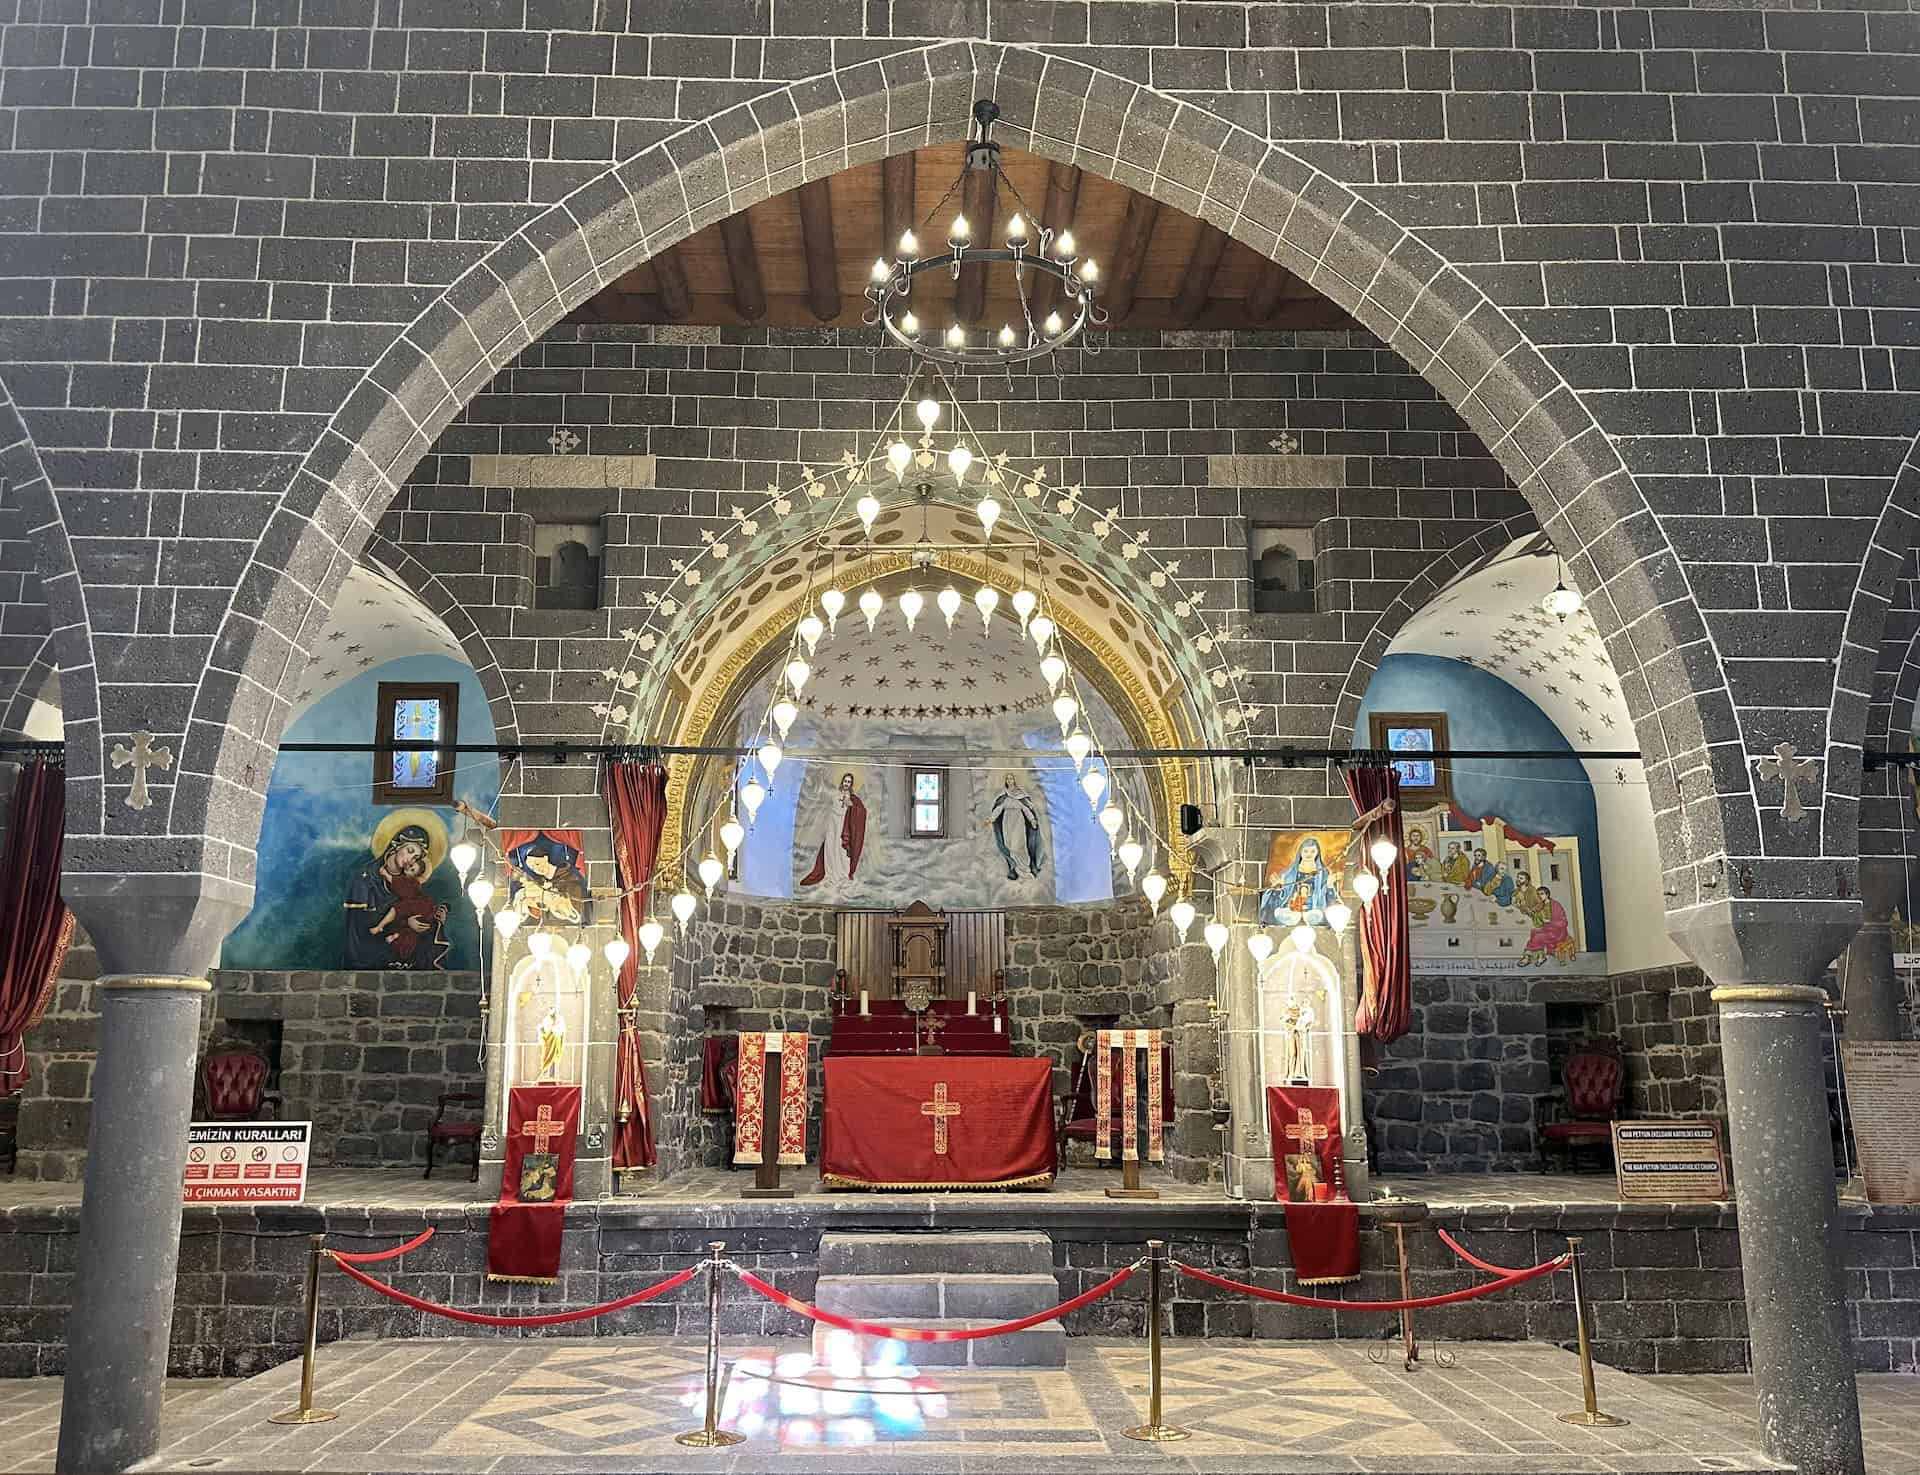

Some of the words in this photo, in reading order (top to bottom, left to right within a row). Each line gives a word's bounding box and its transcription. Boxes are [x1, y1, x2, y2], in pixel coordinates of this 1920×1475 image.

[234, 1130, 302, 1141] KURALLARI
[196, 1187, 240, 1199] ÇIKMAK
[243, 1187, 297, 1198] YASAKTIR
